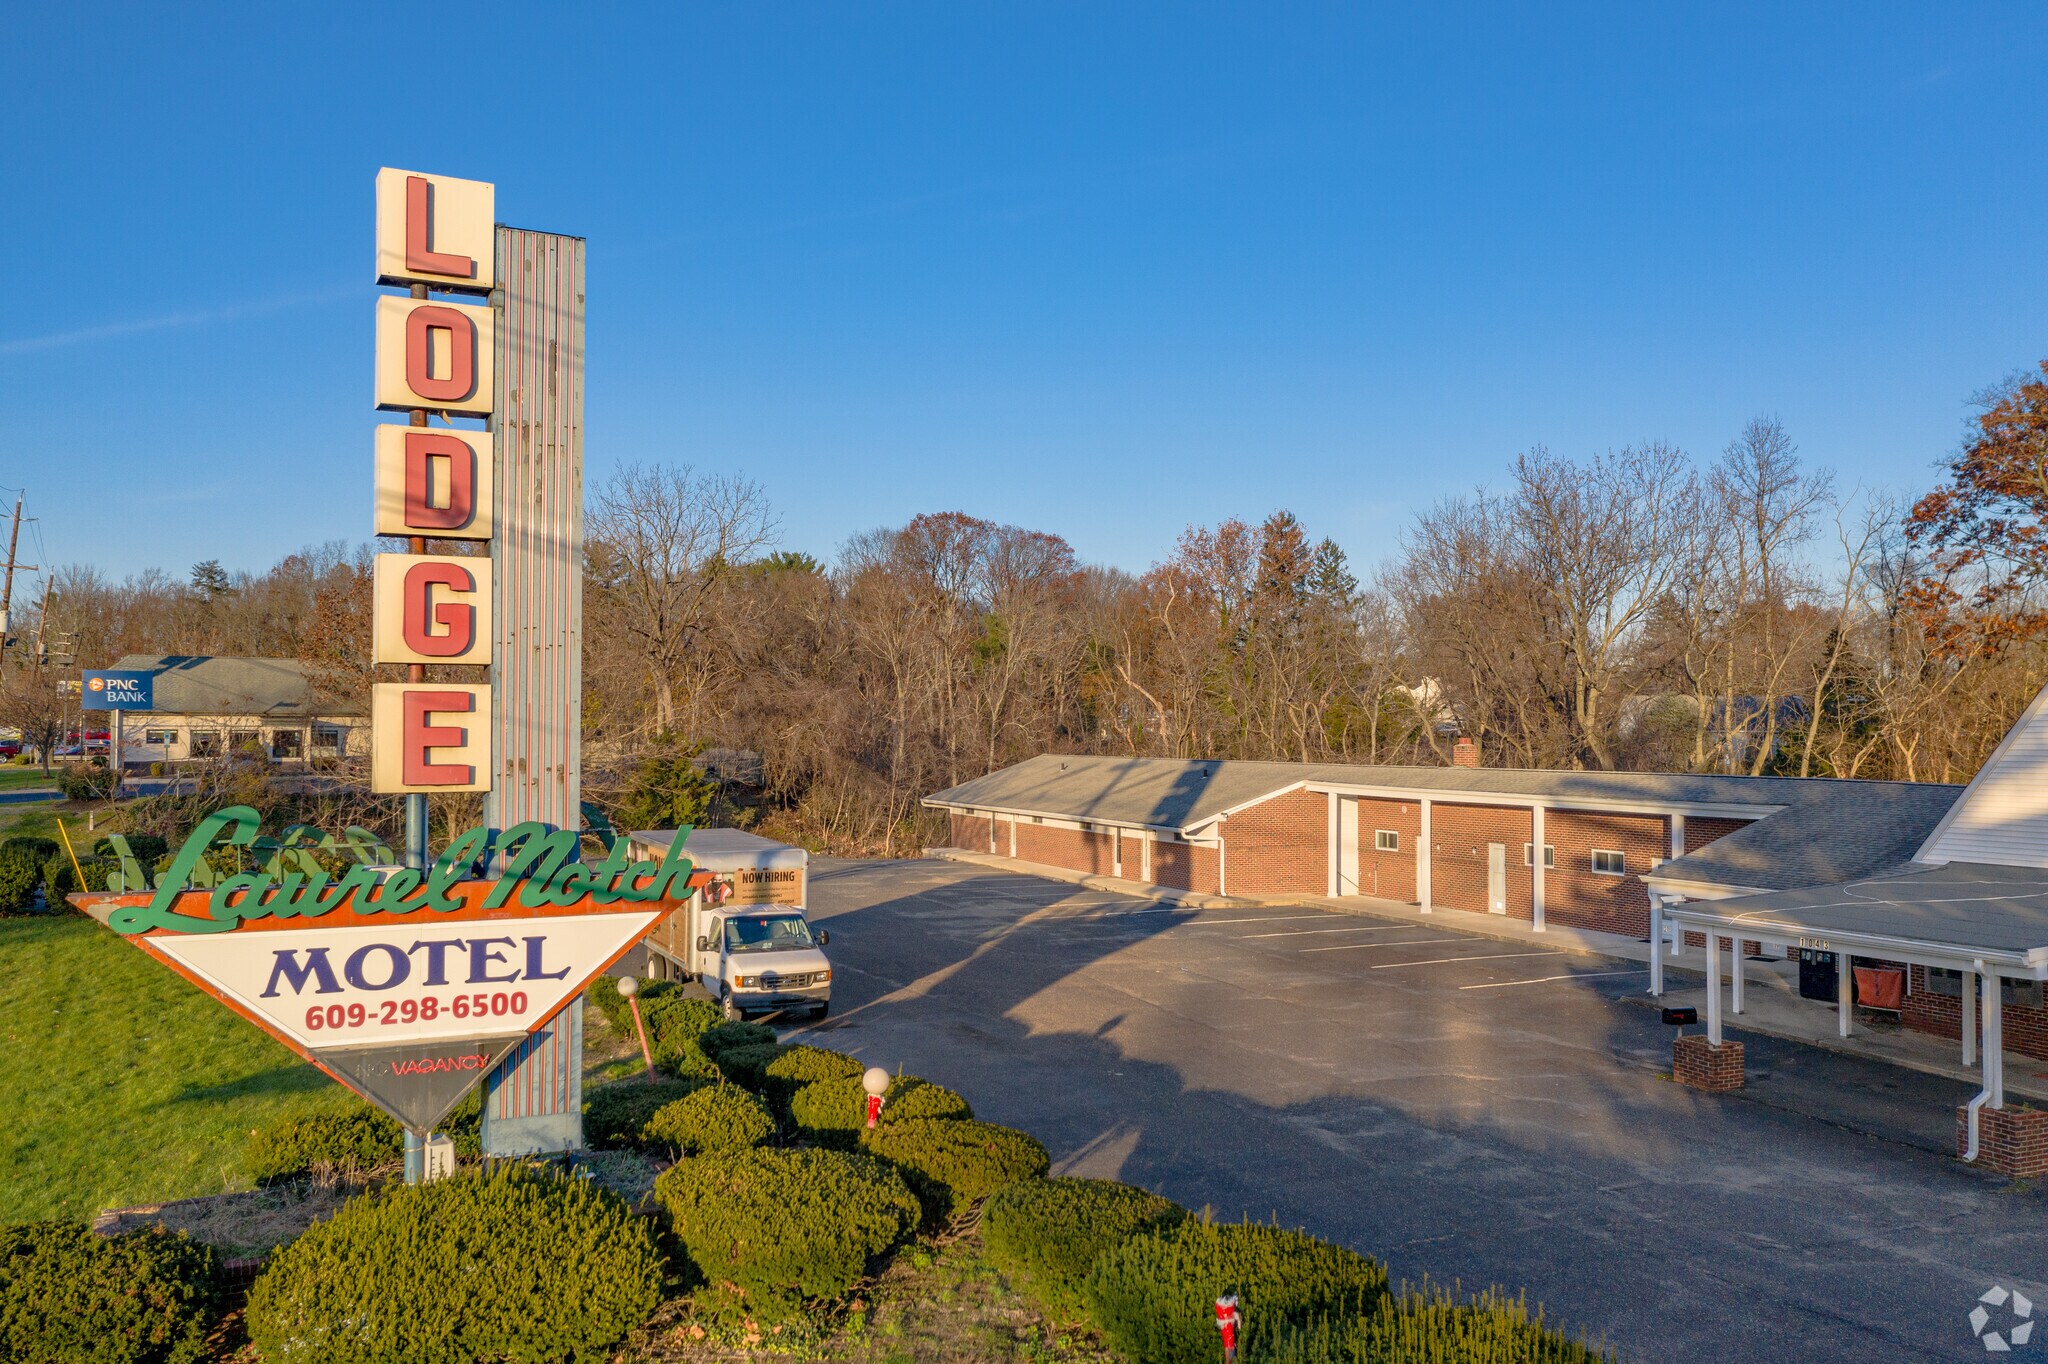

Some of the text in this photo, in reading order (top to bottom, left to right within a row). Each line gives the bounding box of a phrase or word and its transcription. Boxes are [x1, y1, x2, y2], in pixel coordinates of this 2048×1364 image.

[403, 176, 472, 786] LODGE
[106, 679, 139, 691] PNC
[106, 691, 147, 702] BANK
[108, 805, 488, 934] Laurel
[481, 820, 695, 909] Notch
[742, 871, 795, 884] NOW HIRING
[1800, 937, 1830, 950] 1043
[259, 936, 572, 998] MOTEL
[305, 991, 528, 1030] 609-298-6500
